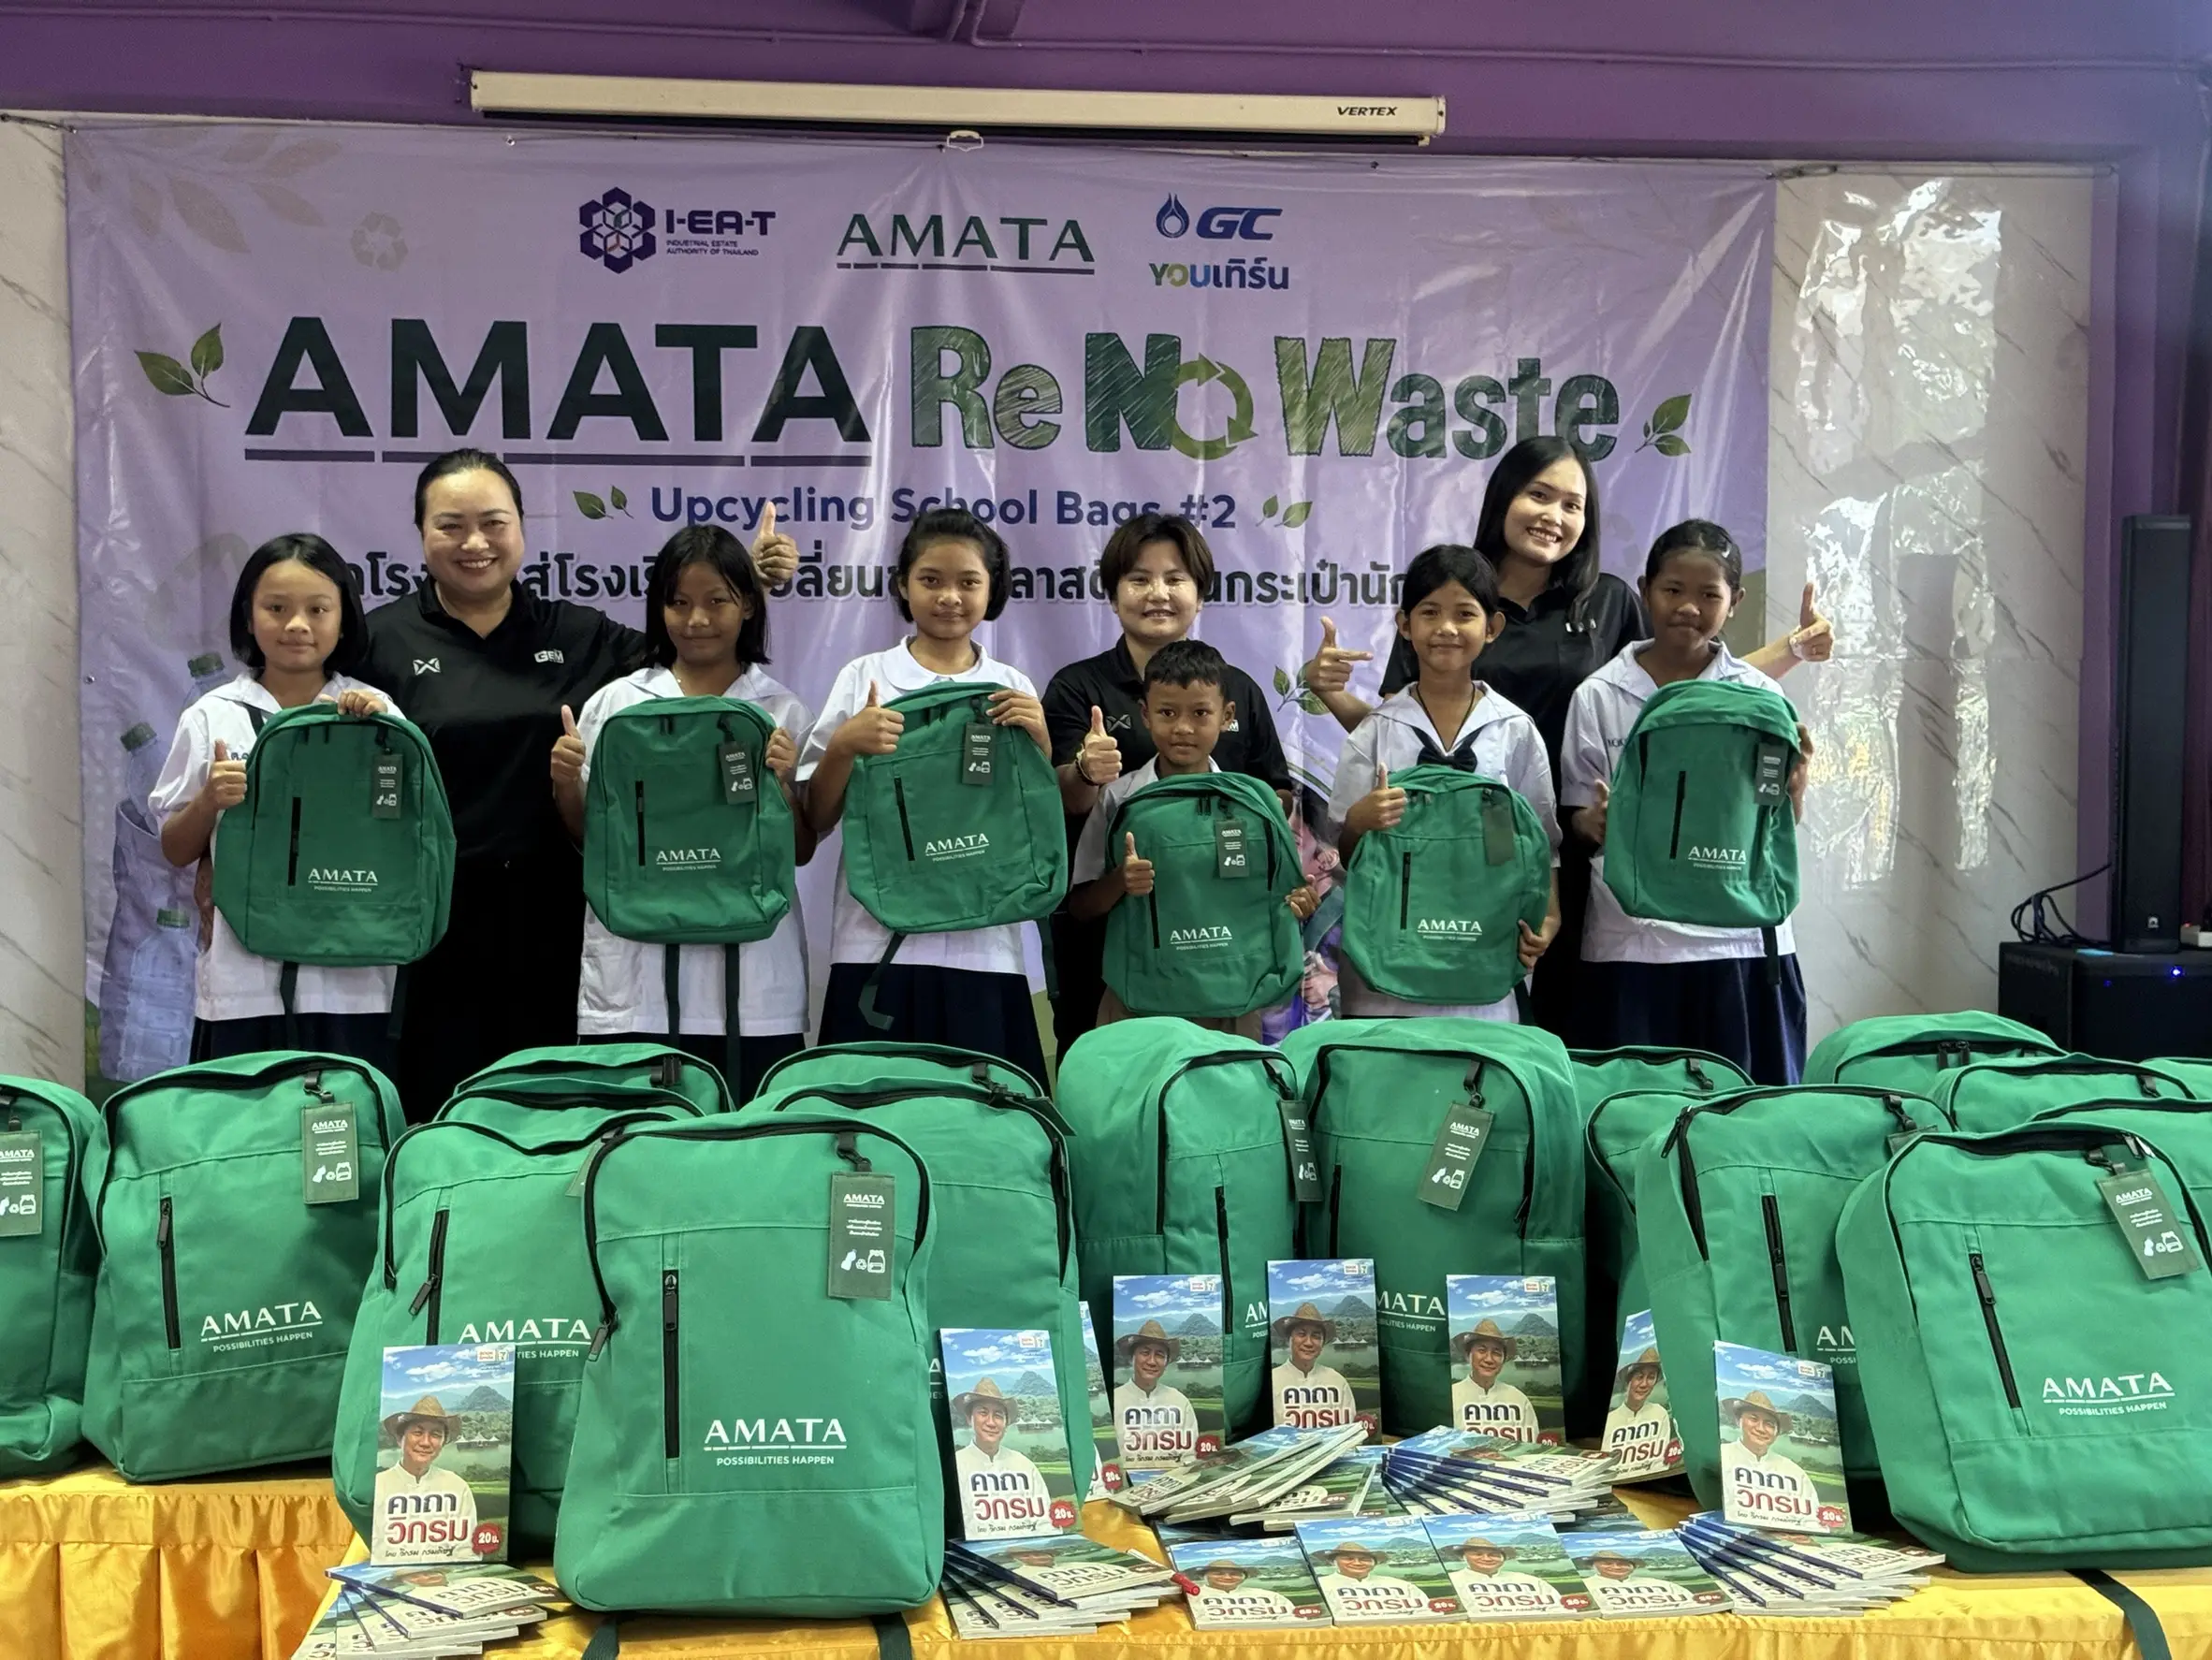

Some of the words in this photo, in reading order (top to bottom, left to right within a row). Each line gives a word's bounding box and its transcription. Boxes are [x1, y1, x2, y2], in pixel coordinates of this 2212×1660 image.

[1336, 106, 1398, 117] VERTEX
[1197, 207, 1283, 240] GC
[666, 240, 709, 248] INDUSTRIAL
[837, 213, 1096, 263] AMATA
[244, 315, 872, 444] AMATA
[1273, 336, 1619, 462] Waste
[652, 487, 874, 531] Upcycling
[891, 488, 1037, 524] School
[1180, 494, 1236, 529] #2
[924, 833, 990, 853] AMATA
[656, 848, 721, 862] AMATA
[1688, 846, 1747, 861] AMATA
[308, 868, 378, 882] AMATA
[1170, 925, 1232, 941] AMATA
[1418, 919, 1482, 933] AMATA
[312, 1119, 348, 1131] AMATA
[1449, 1121, 1479, 1136] AMATA
[843, 1193, 885, 1204] AMATA
[2116, 1187, 2152, 1203] AMATA
[1376, 1290, 1446, 1316] MATA
[200, 1300, 322, 1338] AMATA
[1405, 1322, 1436, 1332] HAPPEN
[458, 1318, 591, 1345] AMATA
[212, 1337, 274, 1353] POSSIBILITIES
[276, 1331, 313, 1345] HAPPEN
[539, 1349, 579, 1358] HAPPEN
[1284, 1387, 1339, 1404] คาถา
[2042, 1372, 2174, 1399] AMATA
[1125, 1406, 1181, 1425] คาถา
[1464, 1404, 1521, 1420] คาถา
[2059, 1405, 2124, 1416] POSSIBILITIES
[2126, 1402, 2167, 1414] HAPPEN
[705, 1418, 848, 1444] AMATA
[1125, 1428, 1192, 1452] วิกรม
[1611, 1421, 1659, 1443] คาถา
[717, 1456, 790, 1466] POSSIBILITIES
[793, 1455, 834, 1464] HAPPEN
[971, 1472, 1029, 1492] คาถา
[1735, 1466, 1797, 1492] คาถา
[387, 1493, 457, 1514] คาถา
[974, 1494, 1045, 1521] วิกรม
[1736, 1484, 1812, 1516] วิกรม
[386, 1517, 468, 1545] วิกรม
